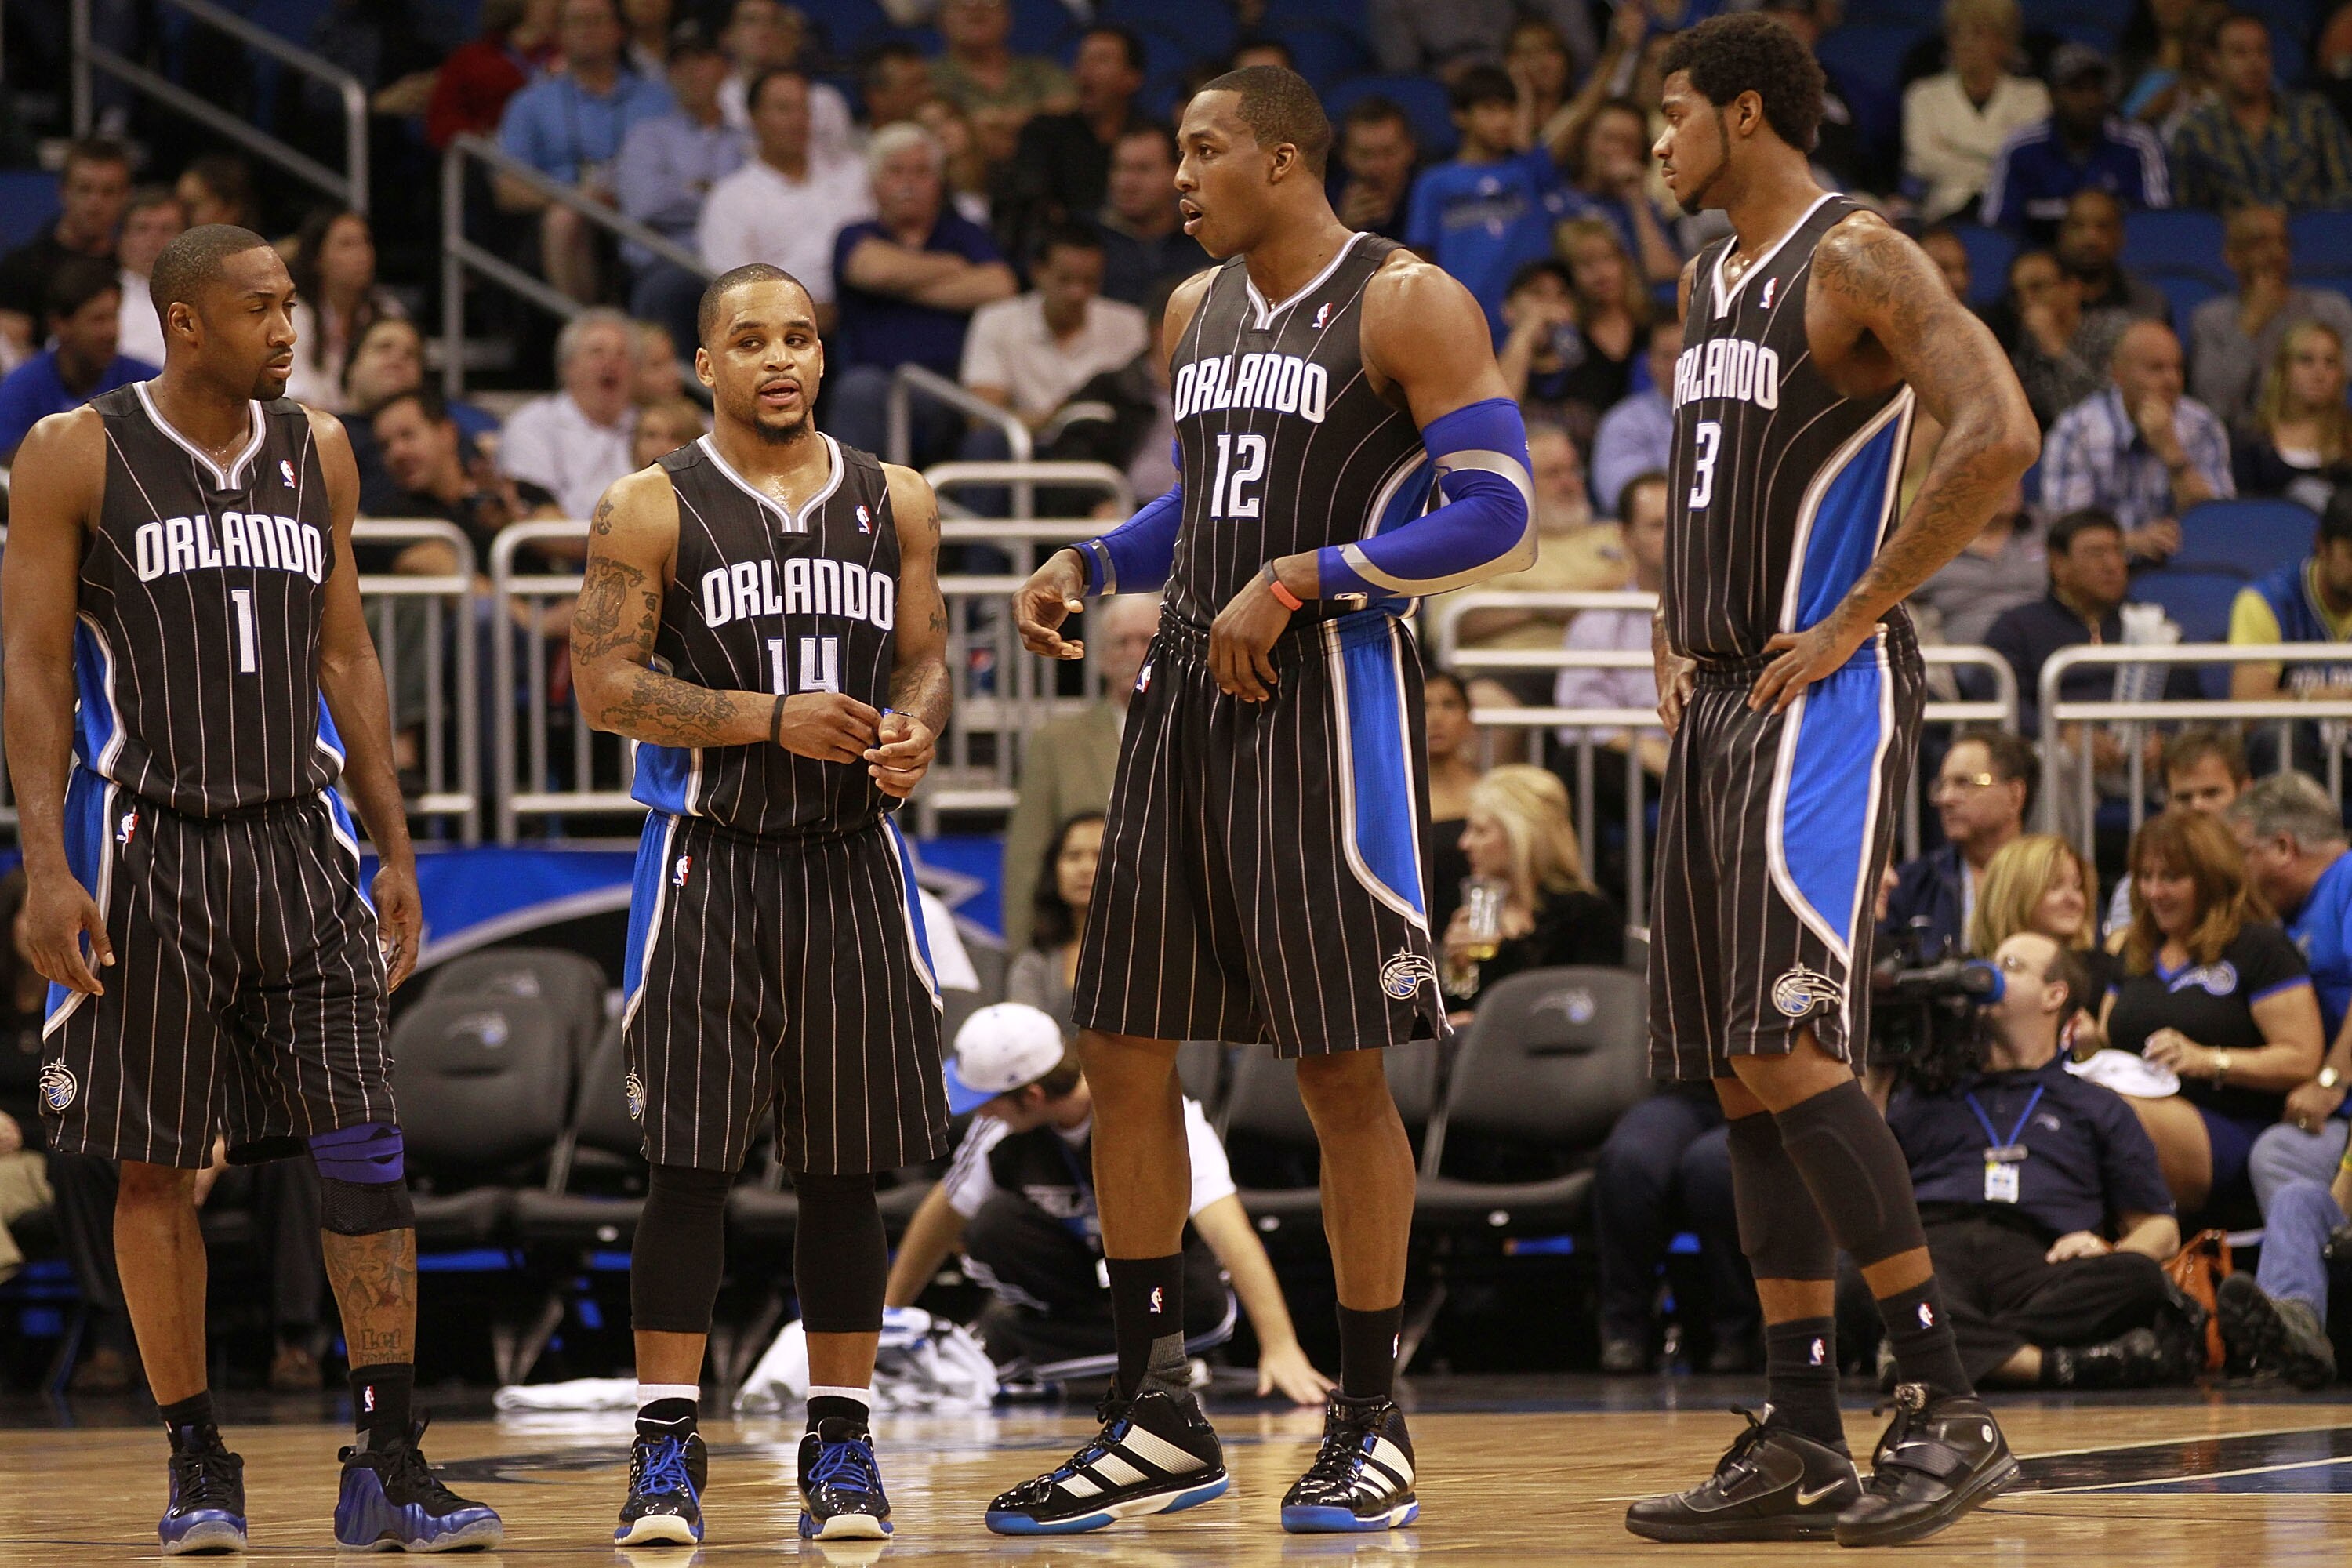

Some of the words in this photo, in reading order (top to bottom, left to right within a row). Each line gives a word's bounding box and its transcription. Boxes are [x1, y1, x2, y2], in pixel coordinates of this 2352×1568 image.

[1174, 354, 1327, 423] ORLANDO
[1211, 434, 1267, 517] 12
[1688, 422, 1721, 510] 3
[136, 512, 322, 584] ORLANDO
[702, 557, 894, 630] ORLANDO
[230, 590, 256, 673] 1
[768, 637, 839, 695] 14
